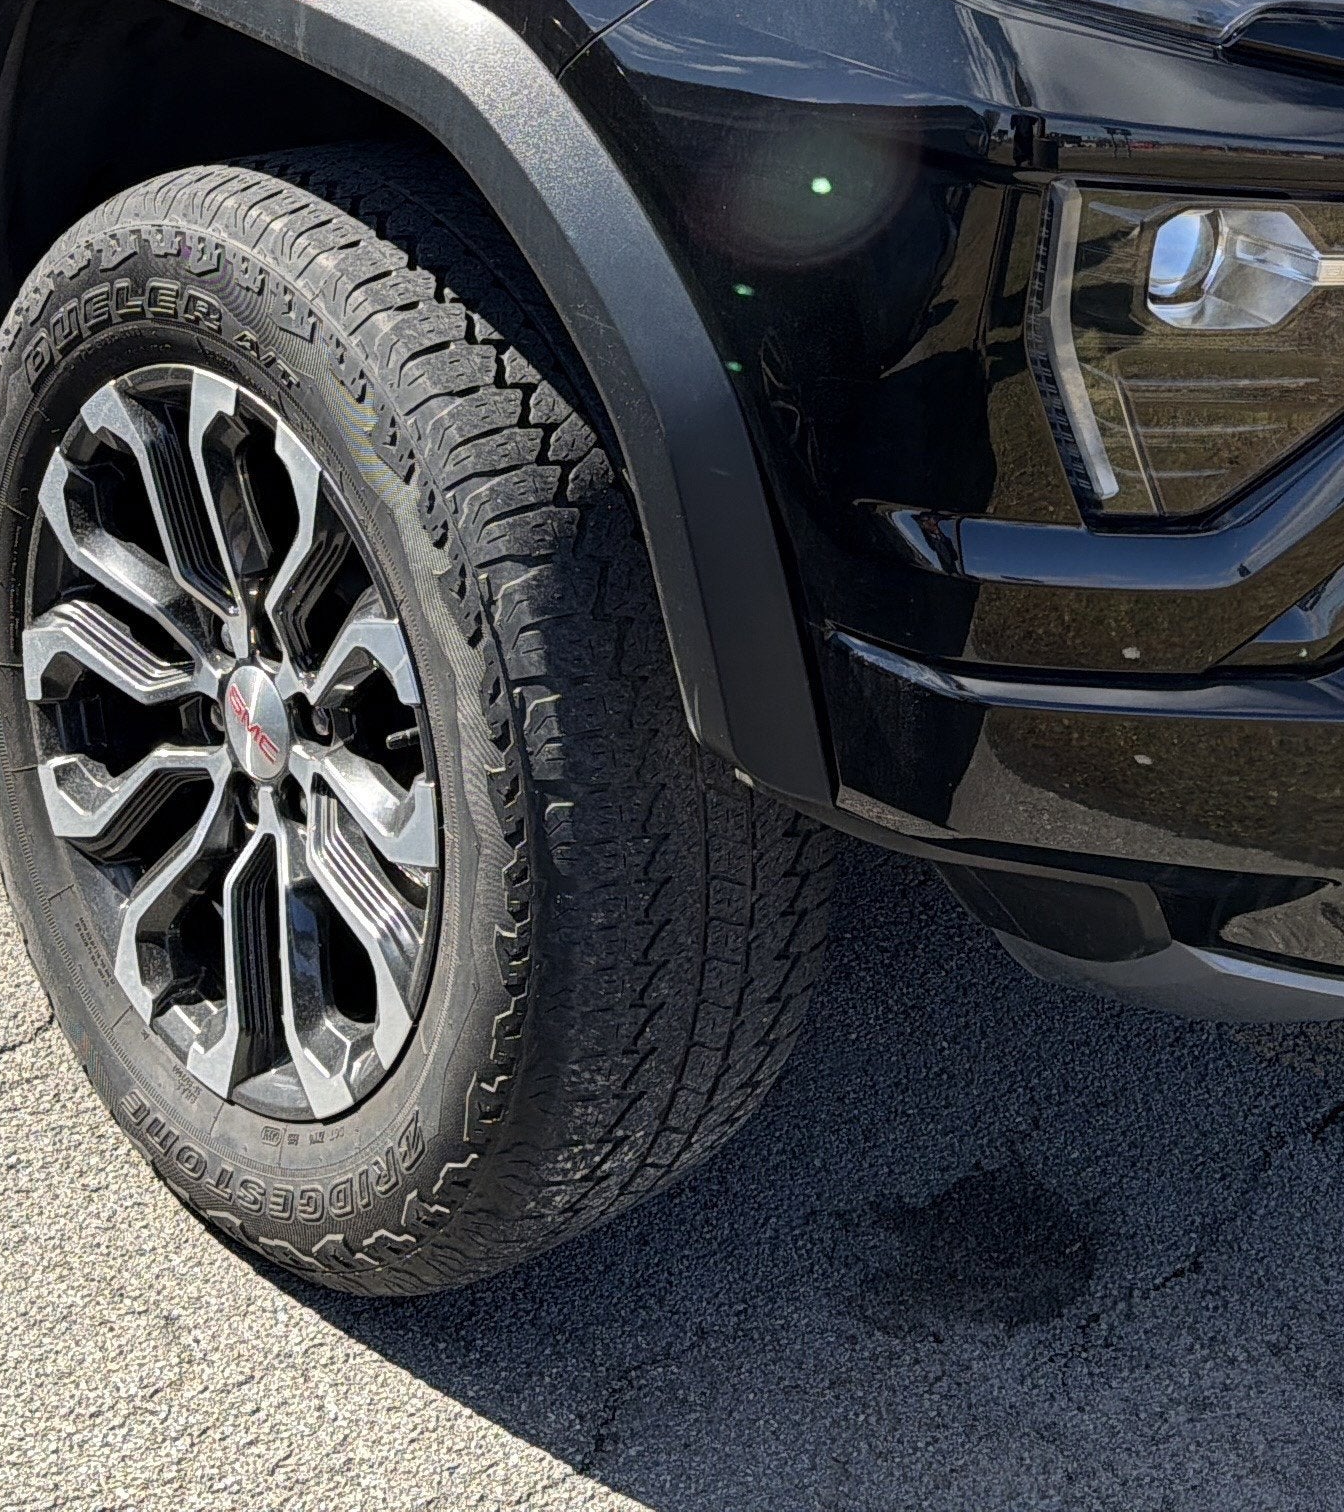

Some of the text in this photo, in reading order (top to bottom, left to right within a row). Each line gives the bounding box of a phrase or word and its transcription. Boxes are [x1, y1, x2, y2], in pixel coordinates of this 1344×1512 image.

[22, 277, 223, 385] DUELER
[229, 683, 279, 765] GMC
[120, 1091, 426, 1224] BRIDGESTONE
